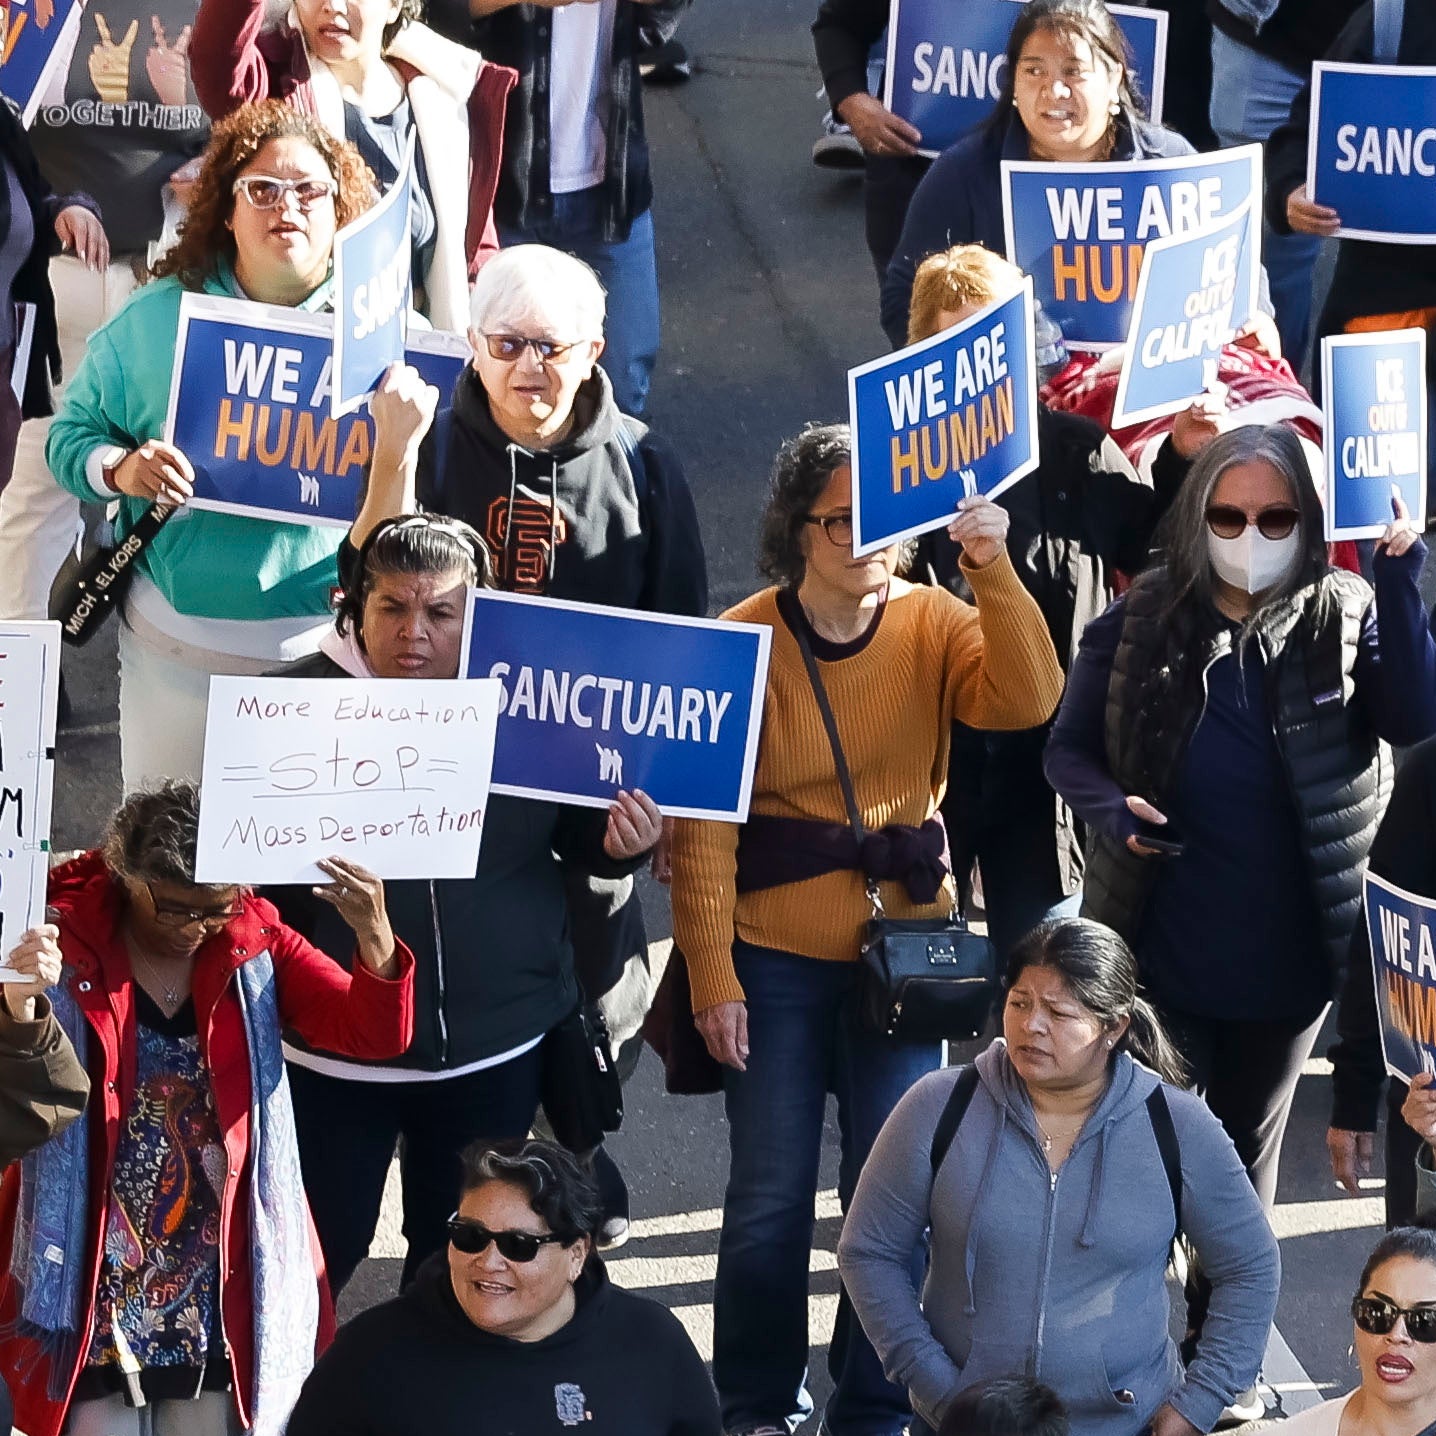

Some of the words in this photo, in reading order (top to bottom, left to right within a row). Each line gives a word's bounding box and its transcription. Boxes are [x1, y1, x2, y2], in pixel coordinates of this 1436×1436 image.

[1046, 187, 1126, 240] WE
[1136, 176, 1222, 236] ARE
[224, 339, 299, 404] WE
[884, 361, 946, 430] WE
[953, 322, 1008, 402] ARE
[213, 398, 373, 476] HUMA
[891, 375, 1014, 494] HUMAN
[108, 533, 143, 574] KORS
[236, 696, 310, 720] More
[334, 695, 479, 723] Education
[488, 661, 733, 745] SANCTUARY
[222, 816, 307, 855] Mass
[319, 805, 482, 843] Deportation
[1379, 904, 1414, 972] WE
